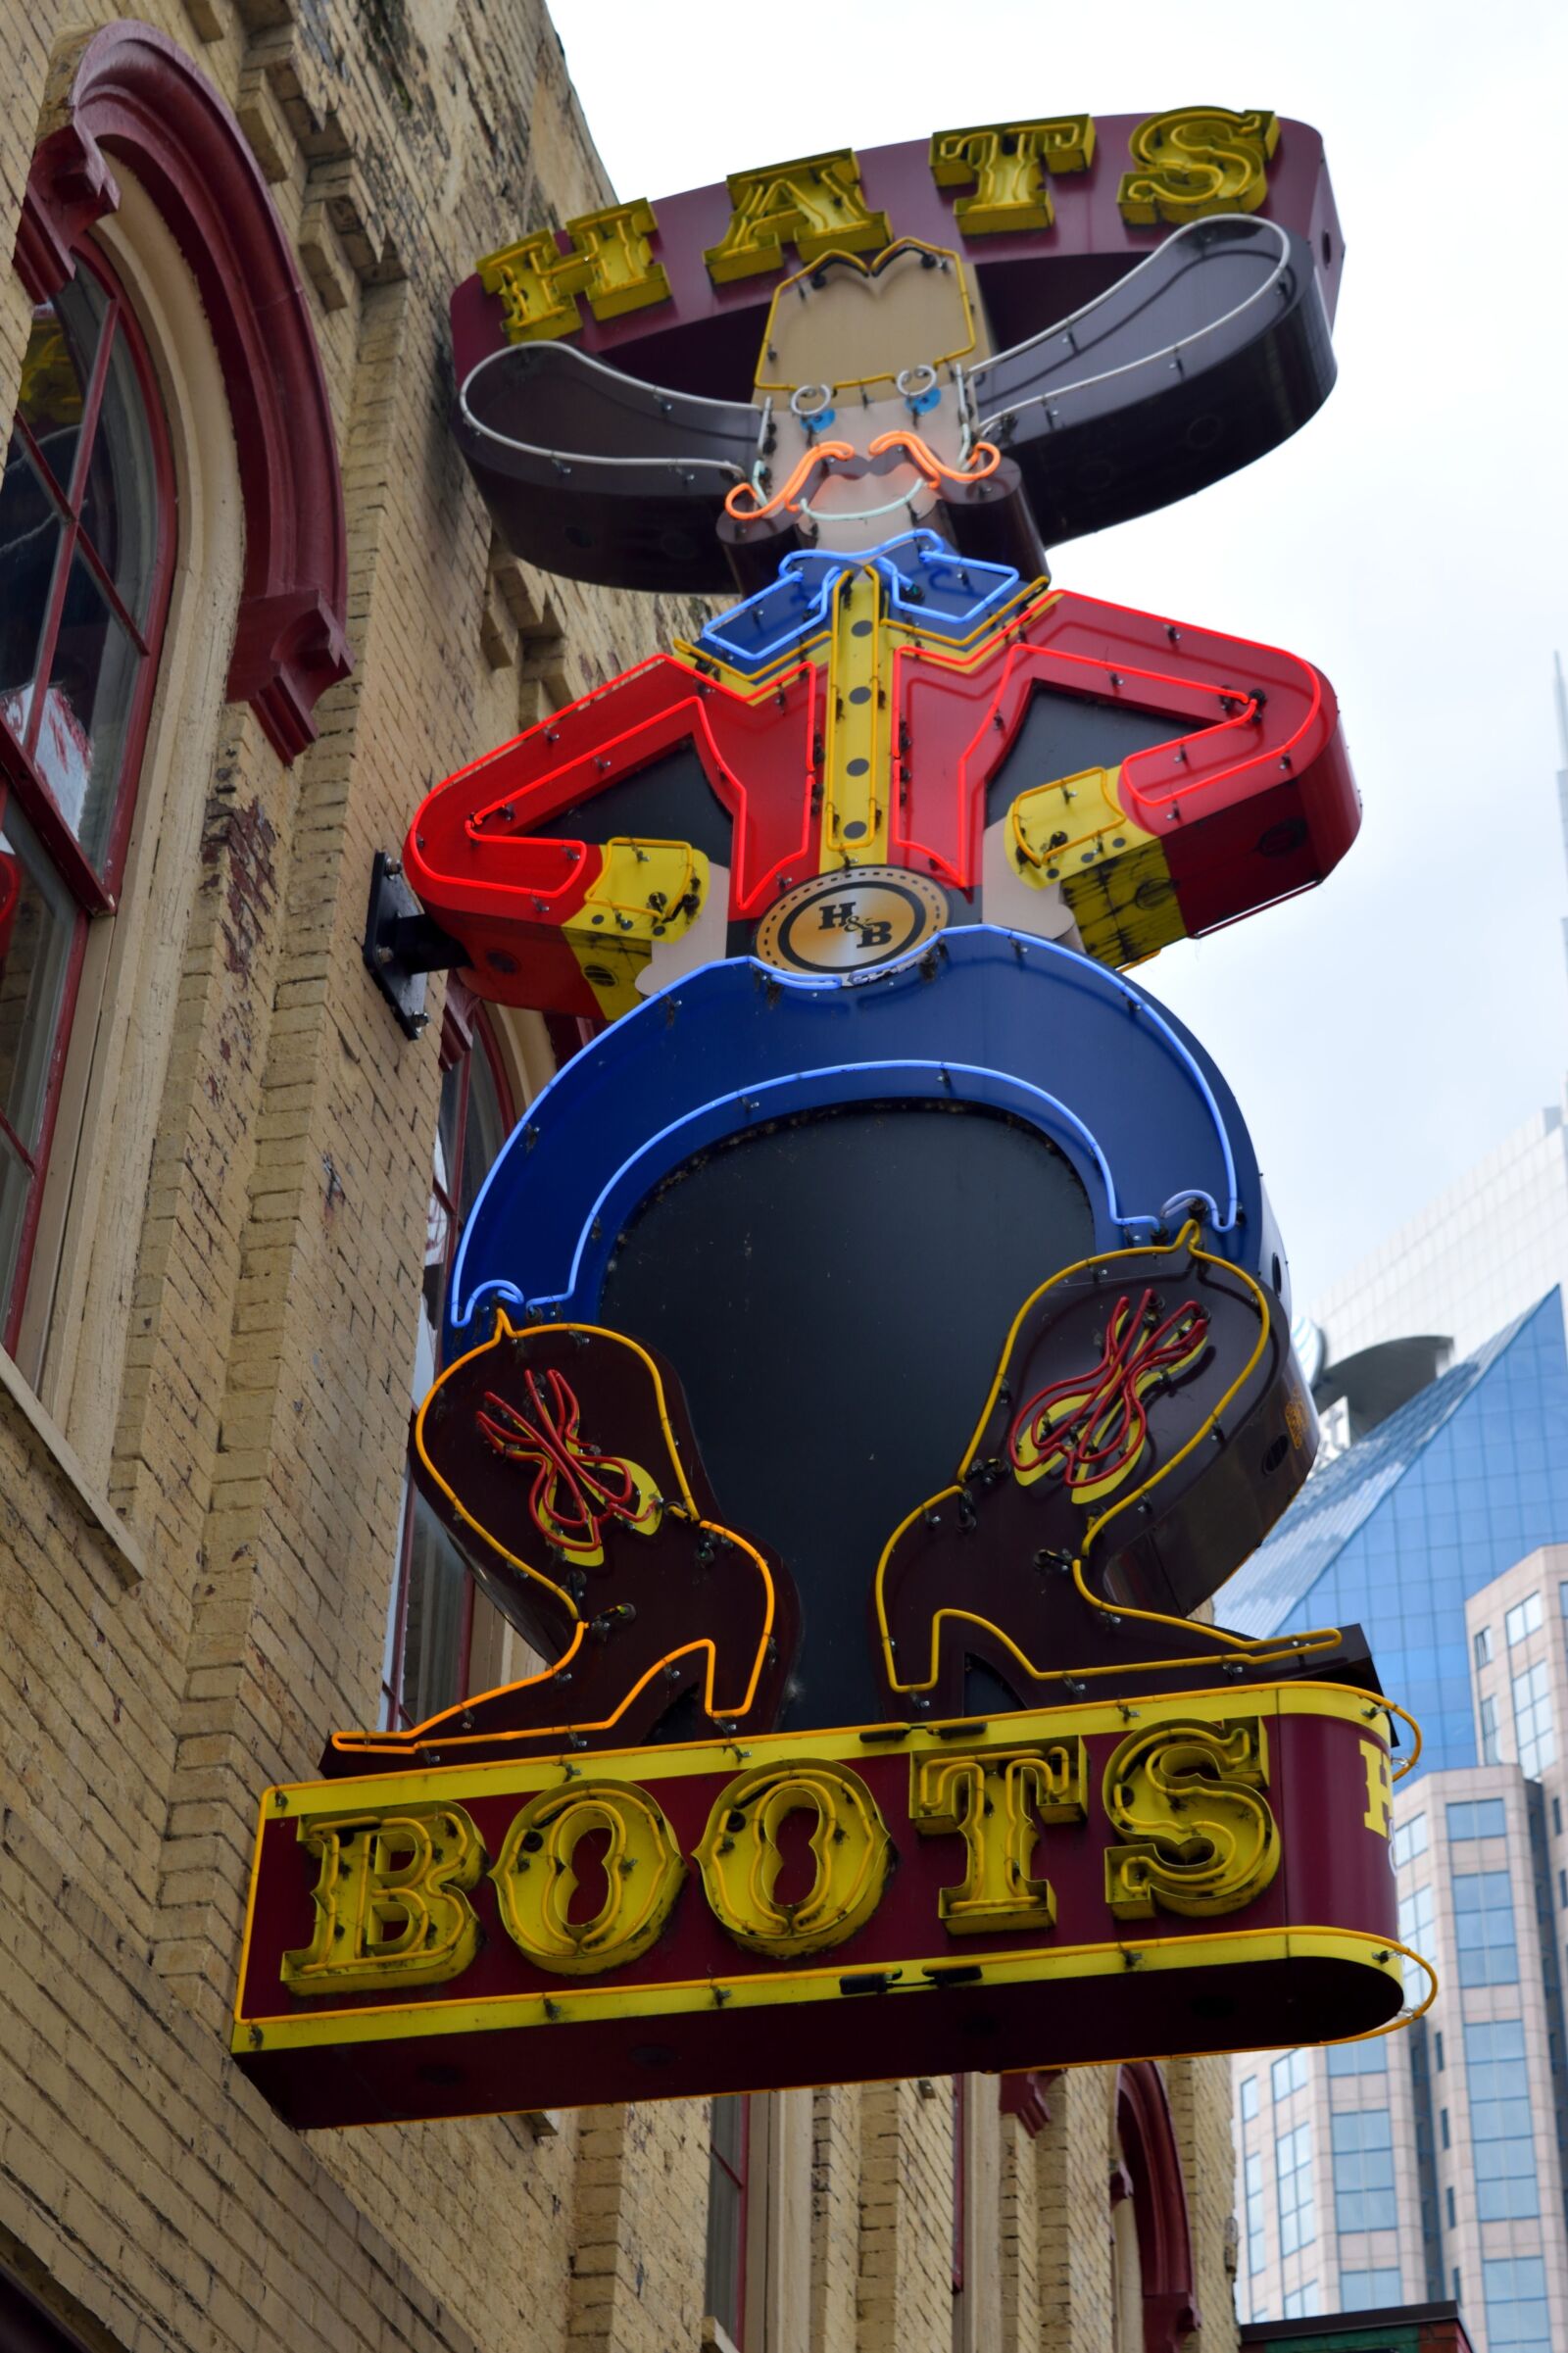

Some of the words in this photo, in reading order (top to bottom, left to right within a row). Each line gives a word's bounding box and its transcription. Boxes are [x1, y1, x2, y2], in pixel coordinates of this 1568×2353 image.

[475, 106, 1281, 344] HATS
[817, 901, 893, 949] H&B
[280, 1715, 1281, 1995] BOOTS
